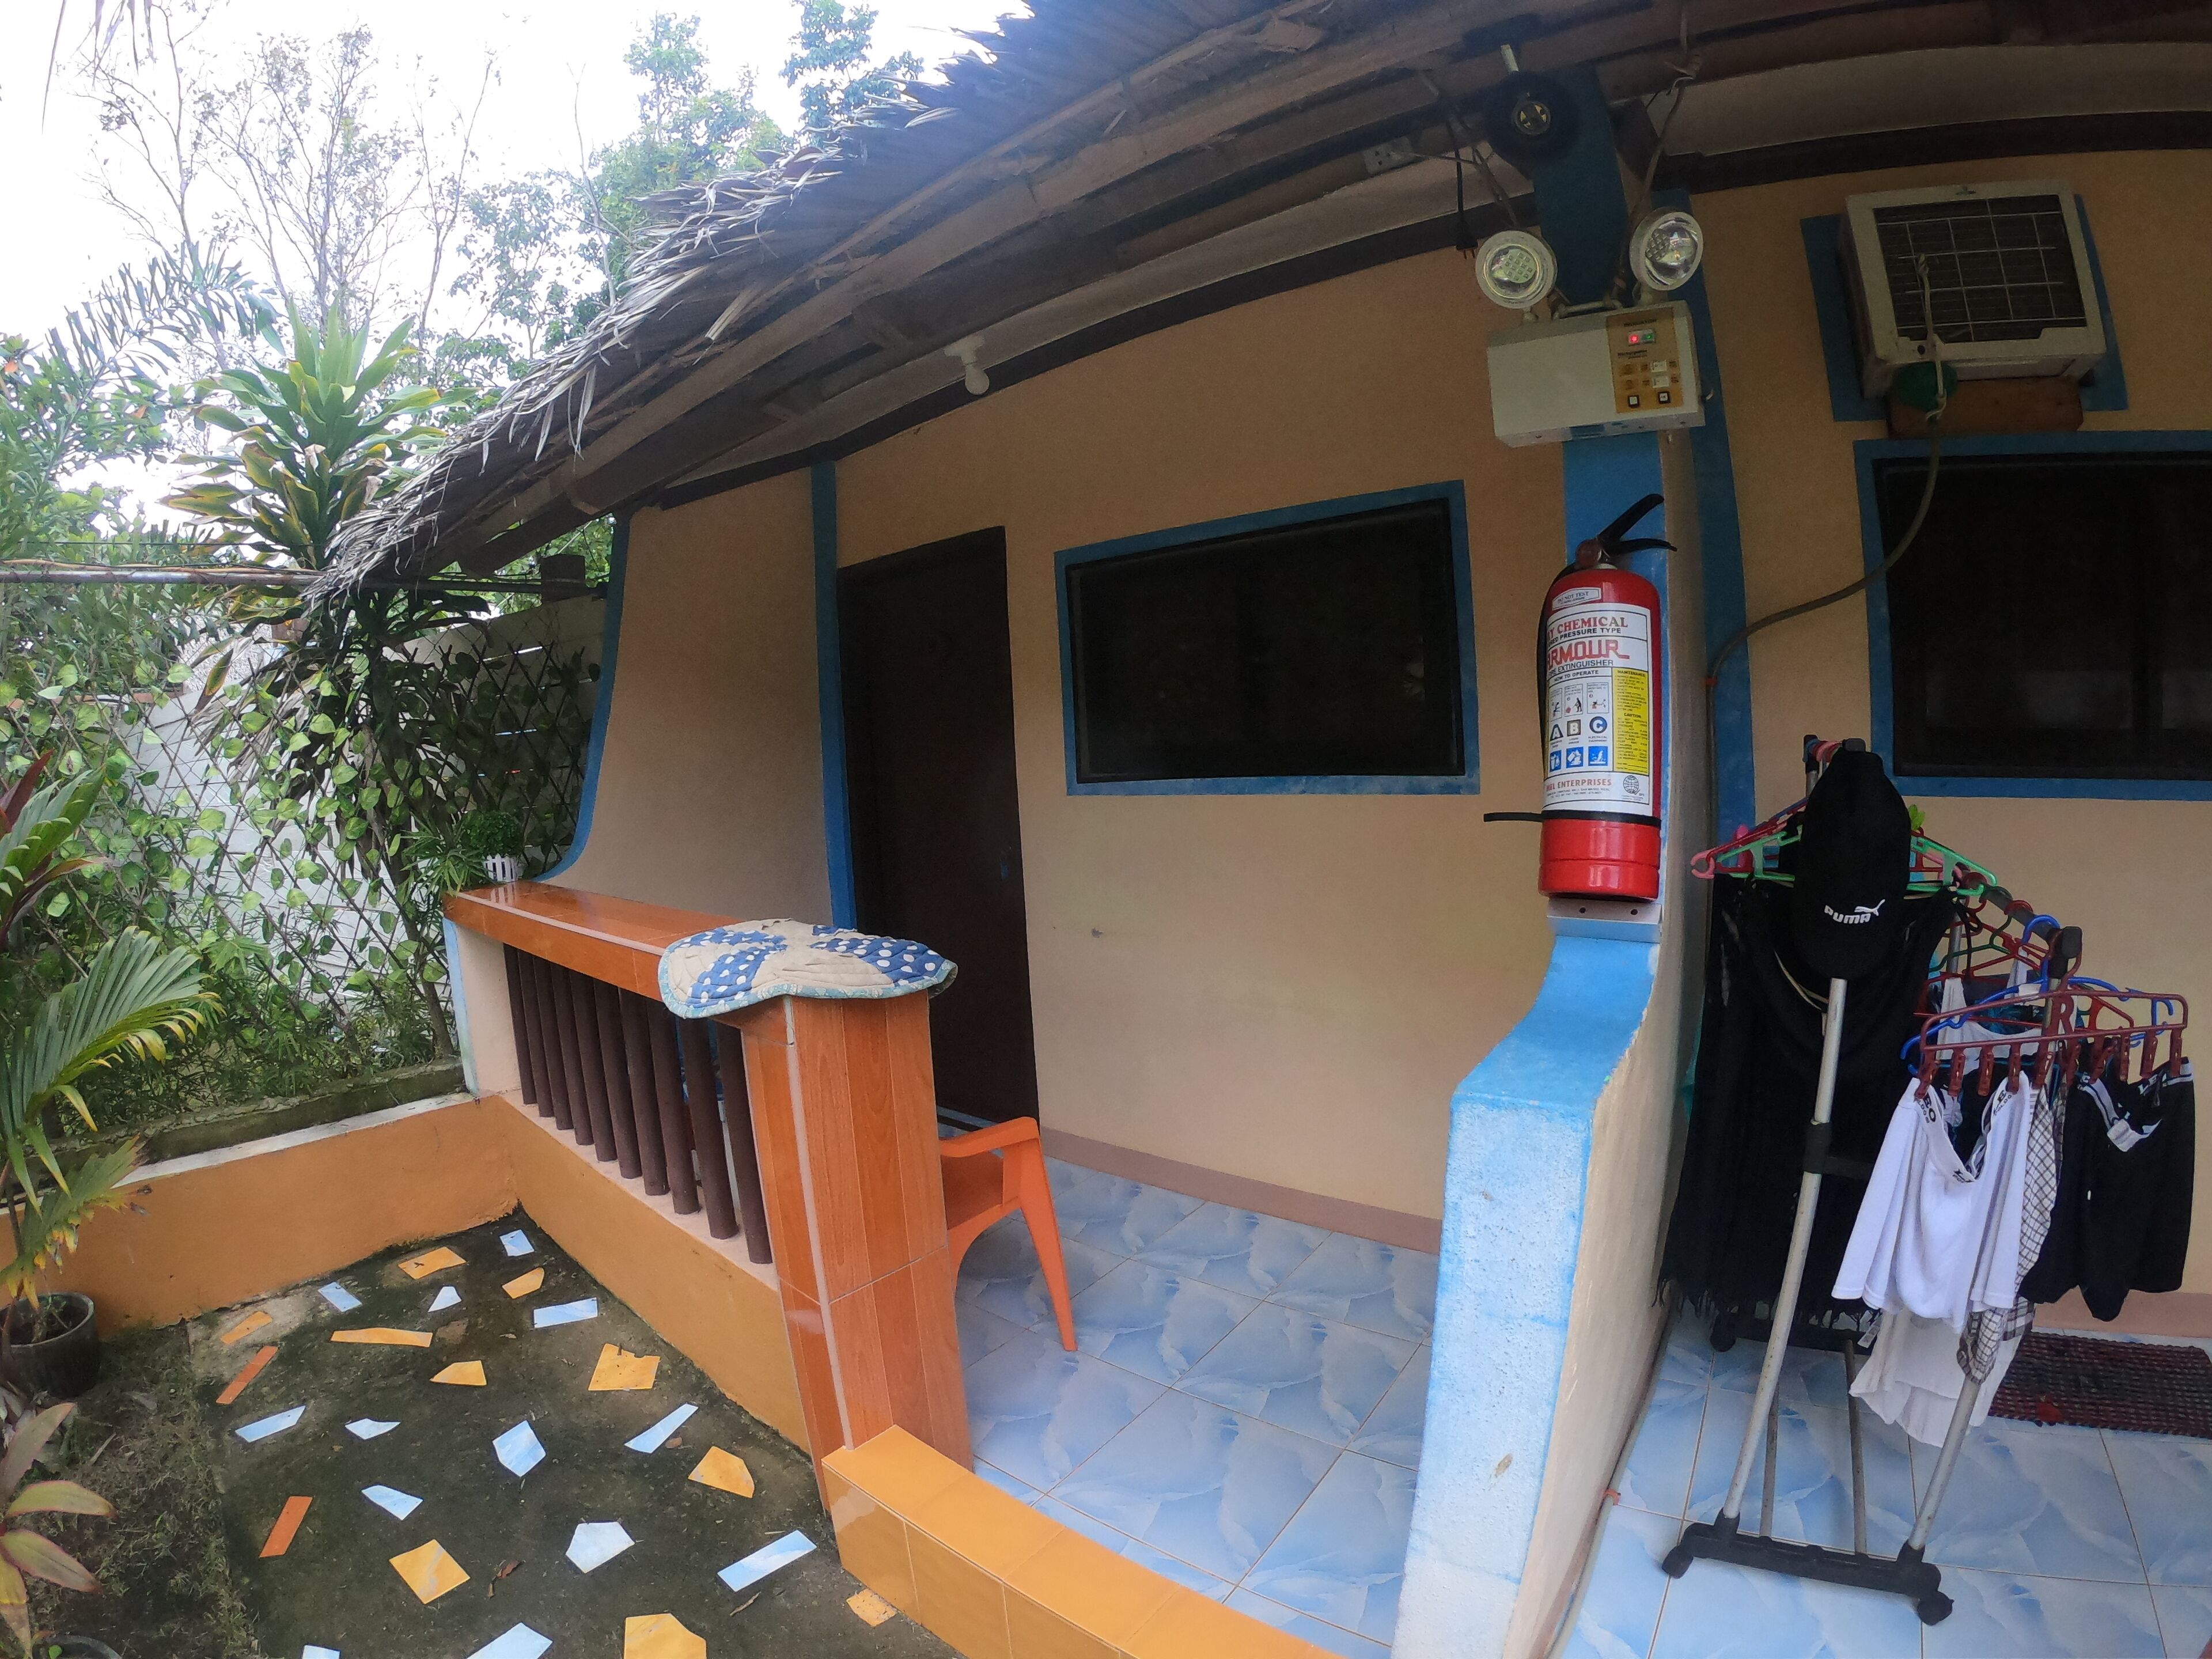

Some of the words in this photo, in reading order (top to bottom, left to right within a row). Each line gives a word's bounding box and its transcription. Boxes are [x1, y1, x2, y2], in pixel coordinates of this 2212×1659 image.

[1557, 616, 1628, 634] CHEMICAL
[1560, 628, 1597, 639] PRESSURE
[1558, 660, 1613, 673] EXTINGUISHER
[1570, 722, 1579, 734] B
[1592, 719, 1604, 732] C
[1557, 779, 1612, 789] ENTERPRISES
[1824, 905, 1871, 924] PUMA
